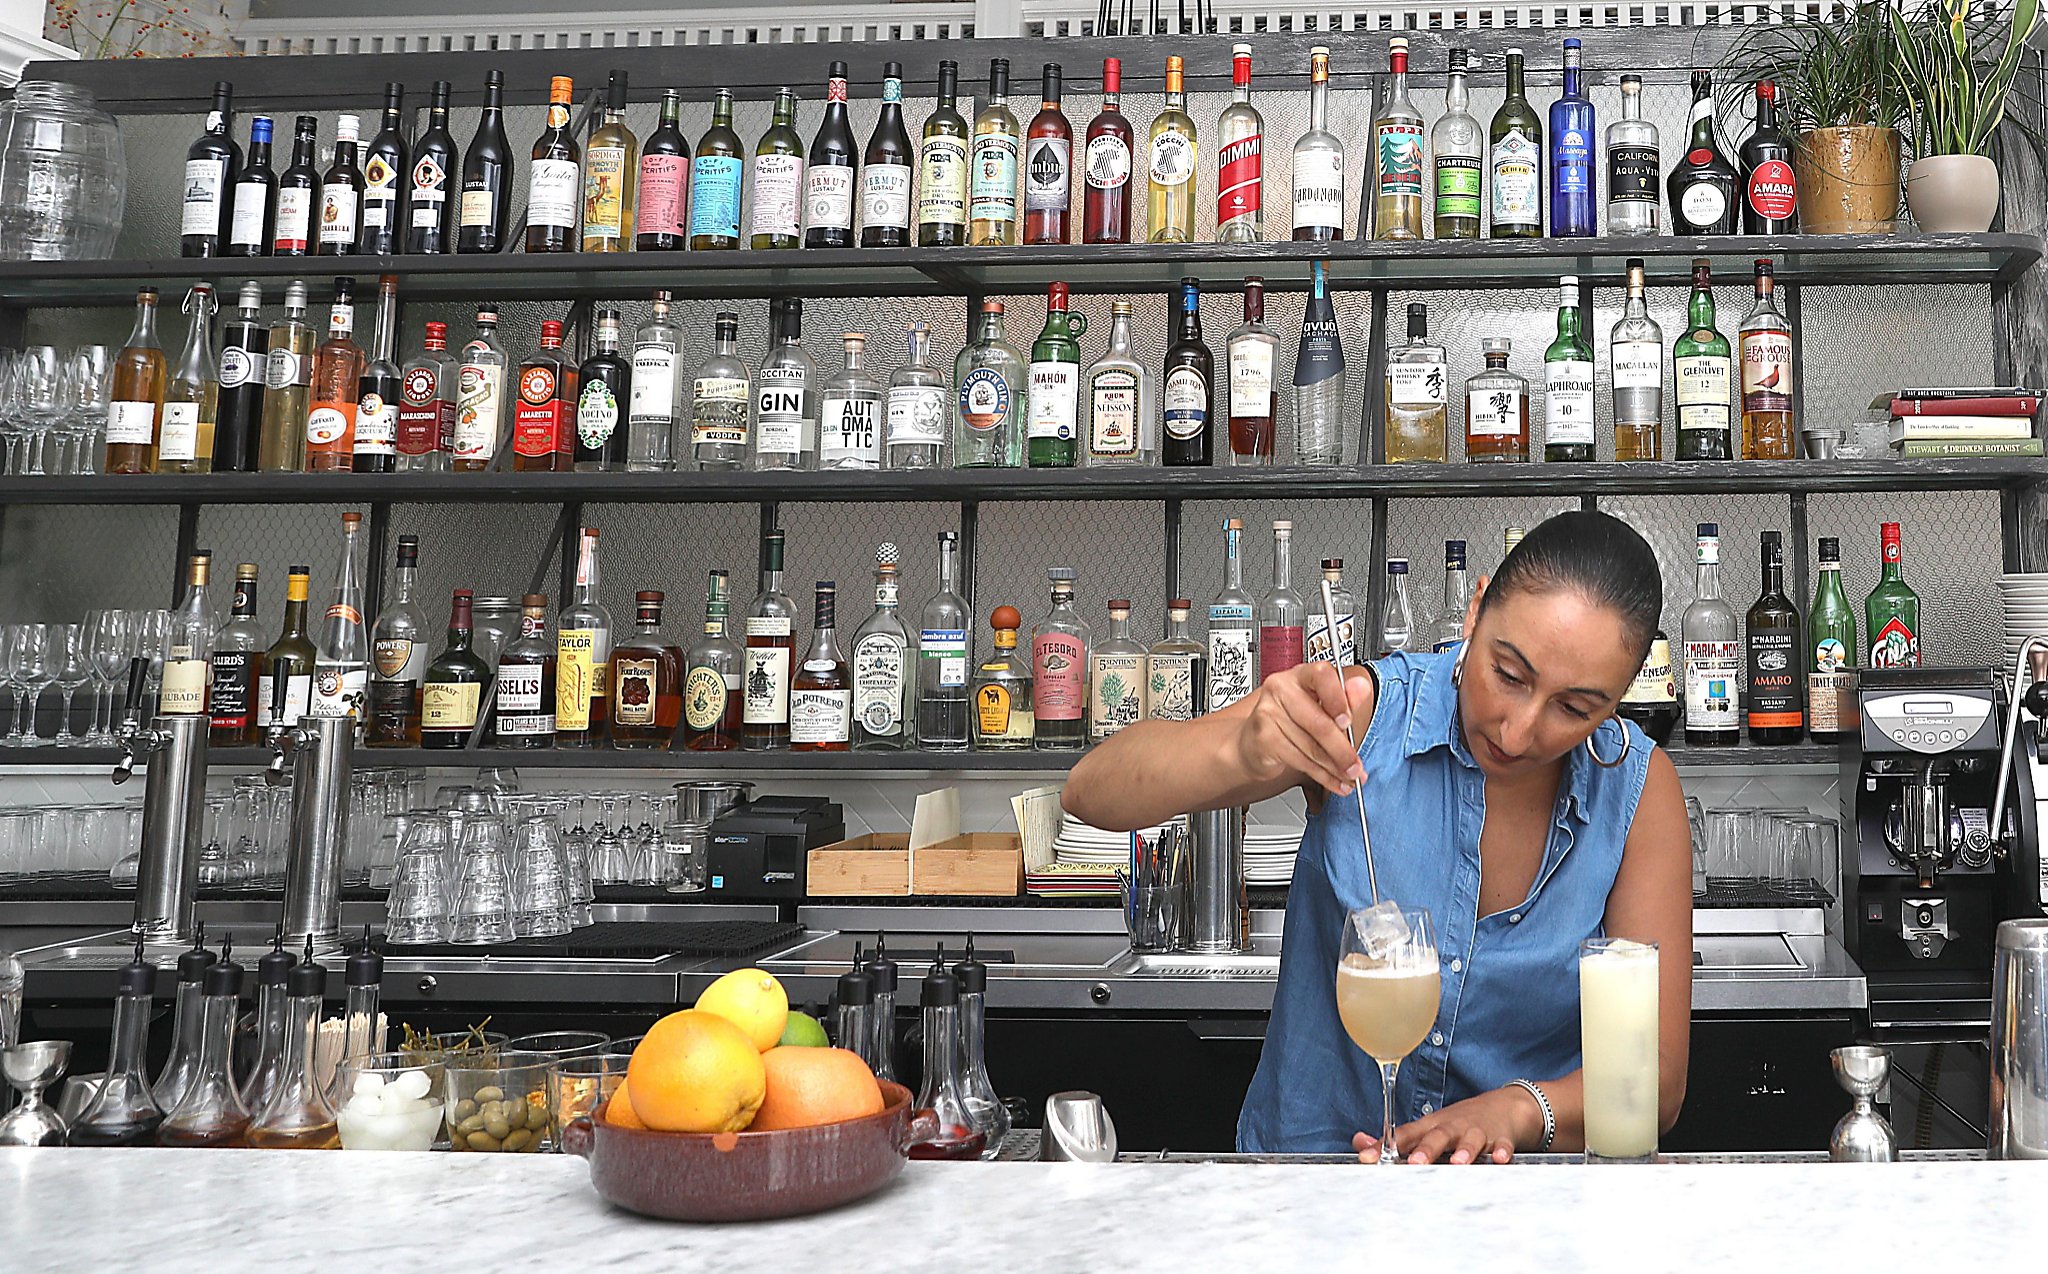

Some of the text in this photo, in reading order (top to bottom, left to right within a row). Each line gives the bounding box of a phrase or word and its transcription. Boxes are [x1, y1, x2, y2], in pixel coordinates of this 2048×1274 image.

[1382, 127, 1420, 135] ALPE
[1156, 138, 1185, 148] COCCHI
[588, 152, 621, 160] BORDIGA
[1220, 138, 1260, 169] DIMMI
[808, 178, 847, 189] VERMUT
[865, 178, 905, 188] VERMUT
[1753, 183, 1794, 195] AMARA
[1304, 321, 1337, 333] avuá
[1752, 345, 1790, 354] FAMOUS
[1752, 354, 1790, 363] GROUSE
[1615, 362, 1658, 371] MACALLAN
[1683, 367, 1725, 376] GLENLIVET
[406, 371, 434, 385] LAZZARONI
[524, 371, 552, 384] LAZZARONI
[761, 370, 802, 378] OCCITAN
[1034, 371, 1067, 385] MAHÓN
[961, 371, 1009, 403] PLYMOUTH GIN
[1545, 381, 1592, 393] LAPHROAIG
[1700, 380, 1710, 389] 12
[524, 388, 552, 400] AMARETTO
[1105, 393, 1124, 401] RHUM
[760, 393, 800, 412] GIN
[842, 401, 874, 416] AUT
[1563, 405, 1572, 415] 10
[842, 416, 873, 432] OMA
[842, 433, 873, 448] TIC
[1950, 445, 1984, 453] DRUNKEN
[948, 632, 964, 640] azul
[1760, 635, 1792, 644] NARDINI
[560, 639, 591, 648] TAYLOR
[1042, 643, 1078, 658] TESORO
[1723, 644, 1739, 658] MONT
[1871, 637, 1918, 669] CYNAR
[1100, 660, 1107, 671] 5
[1153, 660, 1159, 671] 5
[1637, 664, 1672, 679] TENEGRO
[1754, 675, 1792, 686] AMARO
[499, 680, 539, 695] SSELL'S
[803, 694, 843, 710] POTRERO
[503, 720, 513, 730] 10
